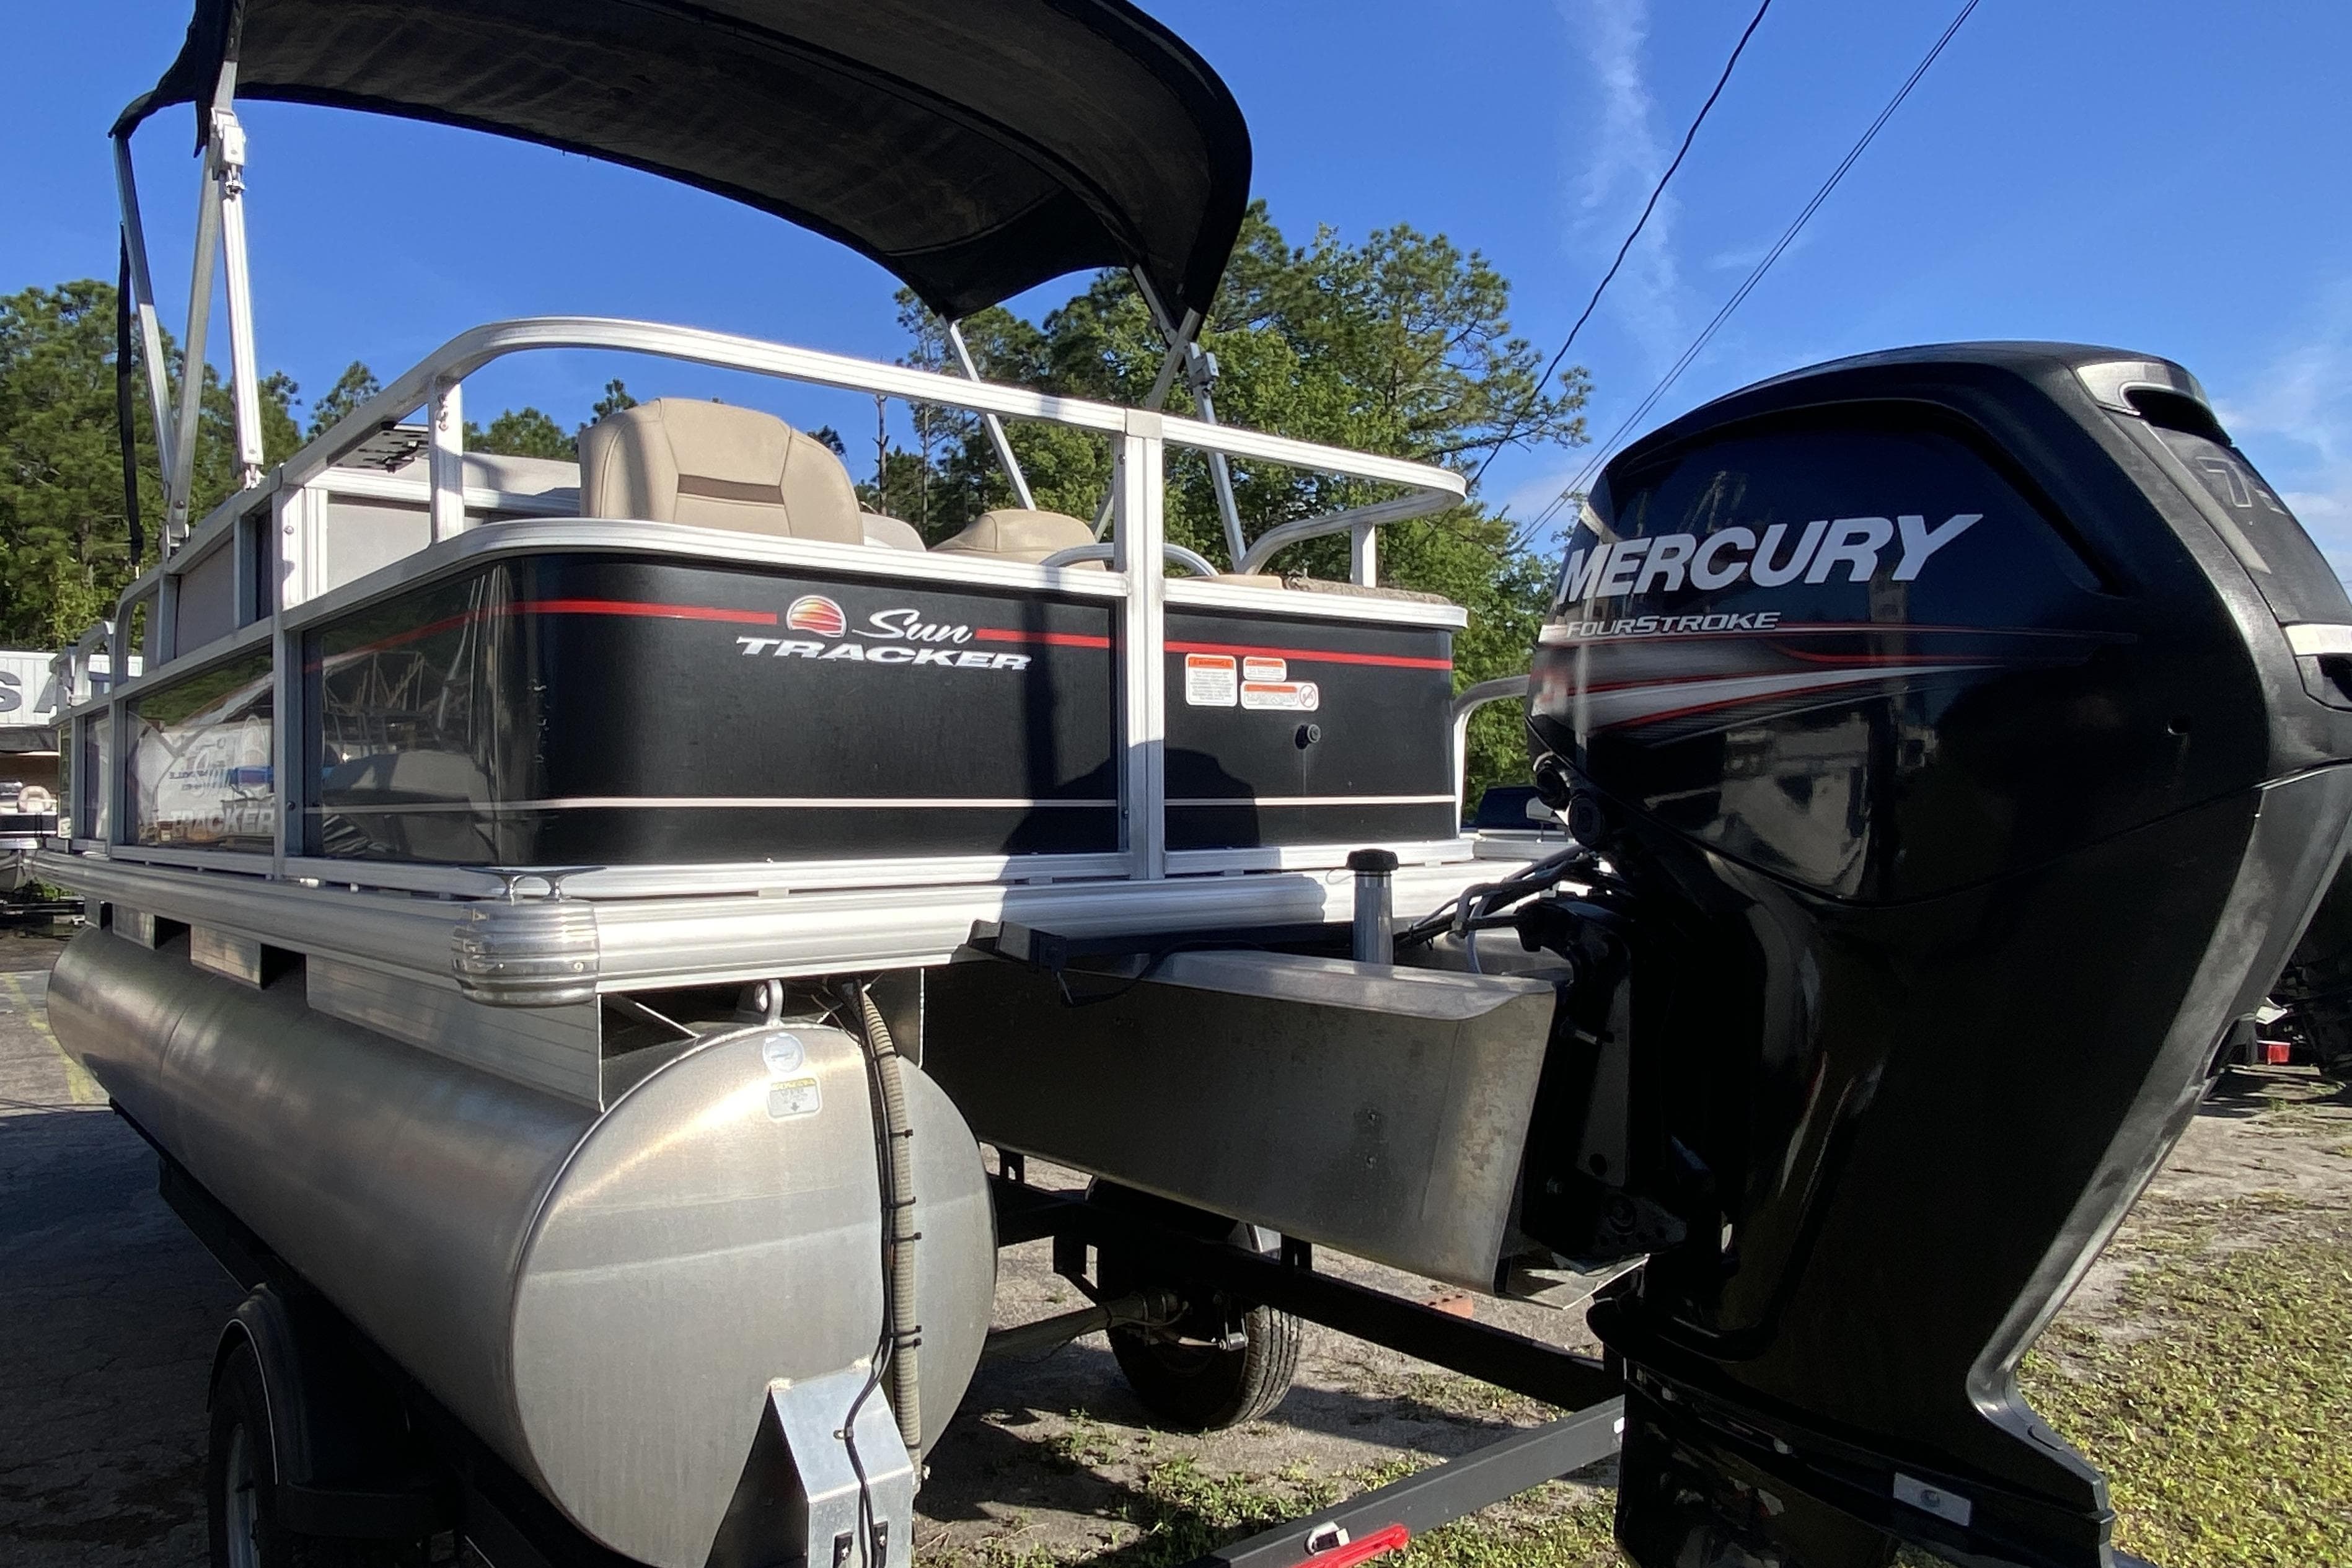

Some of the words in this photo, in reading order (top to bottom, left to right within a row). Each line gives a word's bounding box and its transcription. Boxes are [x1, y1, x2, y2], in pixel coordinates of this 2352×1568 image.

[1556, 513, 1984, 606] MERCURY
[852, 609, 972, 644] Sun
[1566, 611, 1782, 639] FOURSTROKE
[736, 636, 1033, 671] TRACKER
